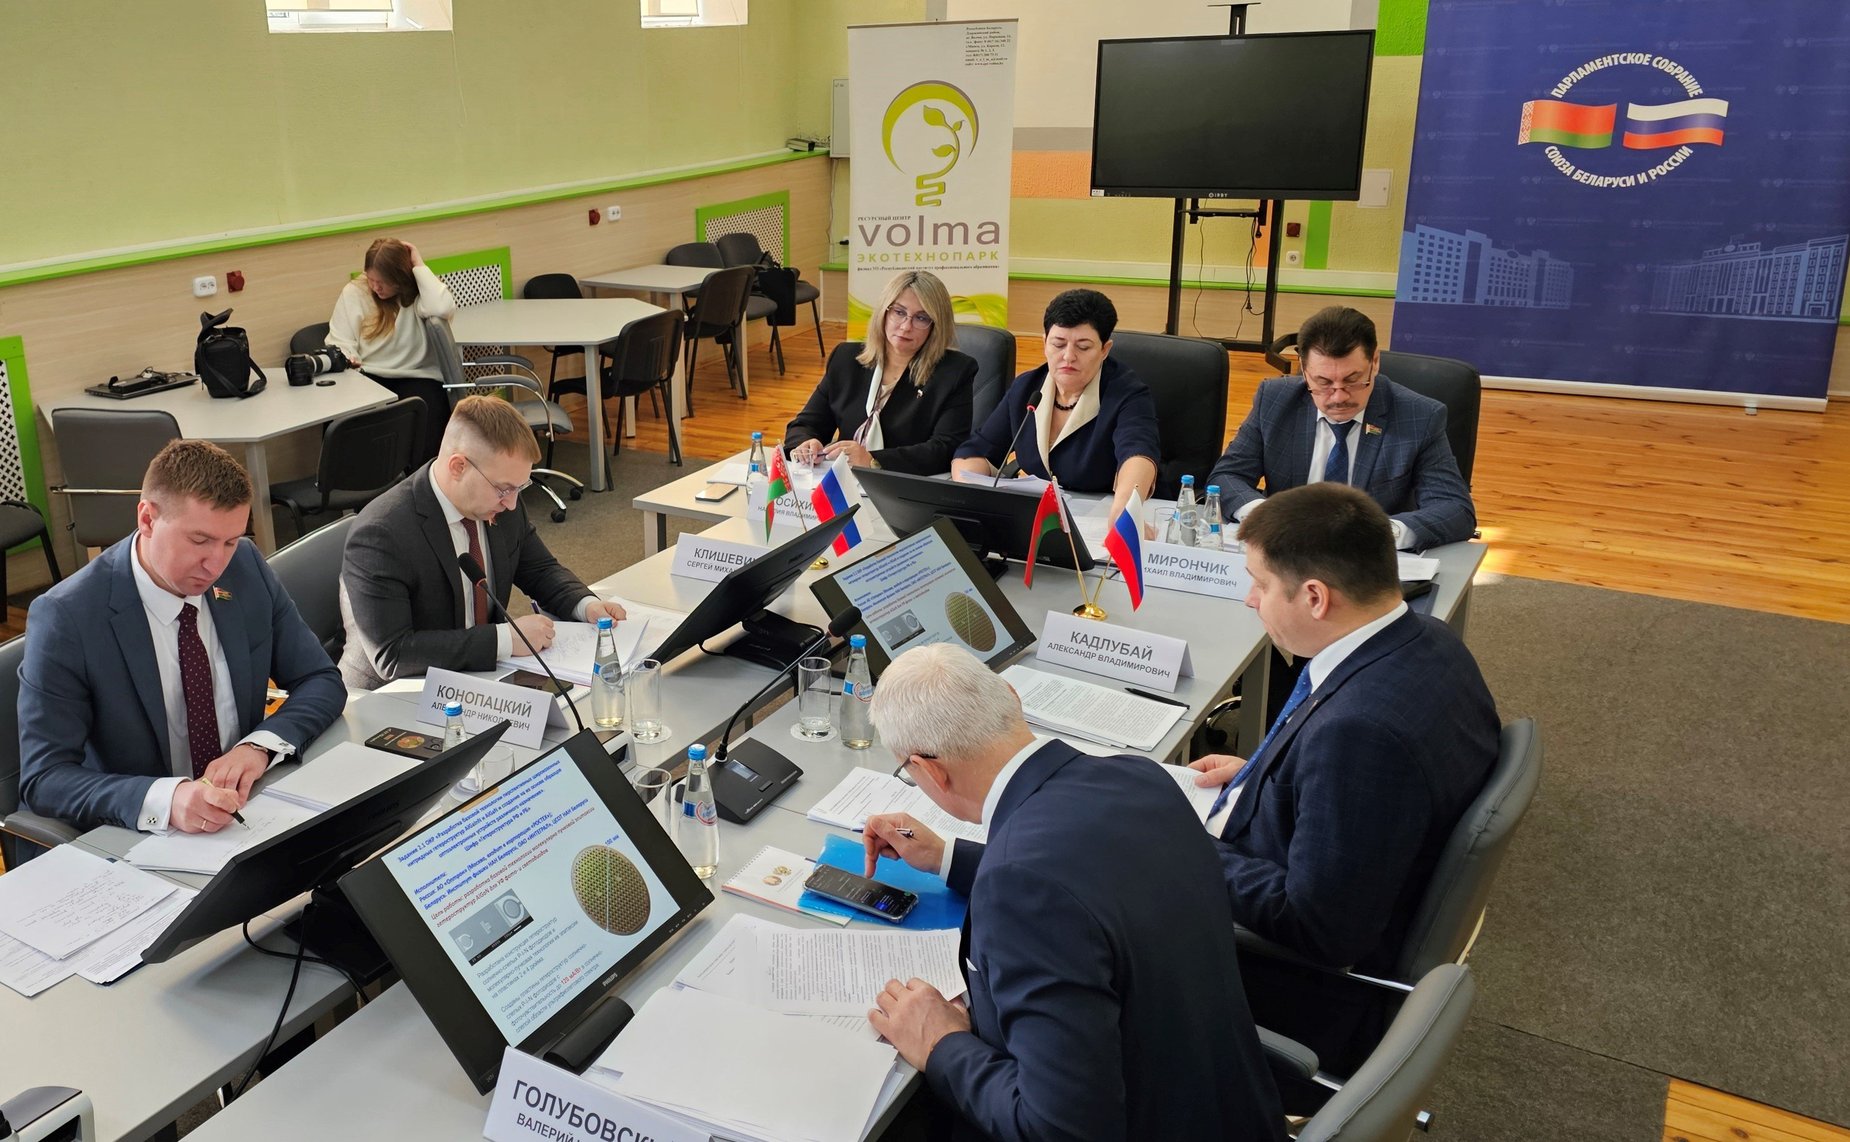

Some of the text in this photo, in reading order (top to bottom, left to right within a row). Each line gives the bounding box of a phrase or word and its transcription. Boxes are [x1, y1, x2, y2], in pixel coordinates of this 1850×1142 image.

[1551, 53, 1703, 98] ПАРЛАМЕНТСКОЕ СОБРАНИЕ
[1545, 145, 1693, 188] СОЮЗА БЕЛАРУСИ И РОССИИ
[858, 215, 1000, 247] volma
[857, 251, 999, 263] ЭКОТЕХНОПАРК
[776, 497, 814, 511] ОСИХИ
[687, 560, 735, 573] СЕРГЕЙ МИХА
[694, 548, 756, 565] КЛИШЕВИ
[1148, 553, 1229, 575] МИРОНЧИК
[1144, 567, 1237, 587] ХАИЛ ВЛАДИМИРОВИЧ
[1047, 642, 1171, 678] АЛЕКСАНДР ВЛАДИМИРОВИЧ
[1070, 631, 1153, 661] КАДЛУБАЙ
[437, 684, 532, 718] КОНОПАЦКИЙ
[431, 702, 530, 731] АЛЕНДР НИКОЛЕВИЧ
[513, 1079, 656, 1142] ГОЛУБОВС
